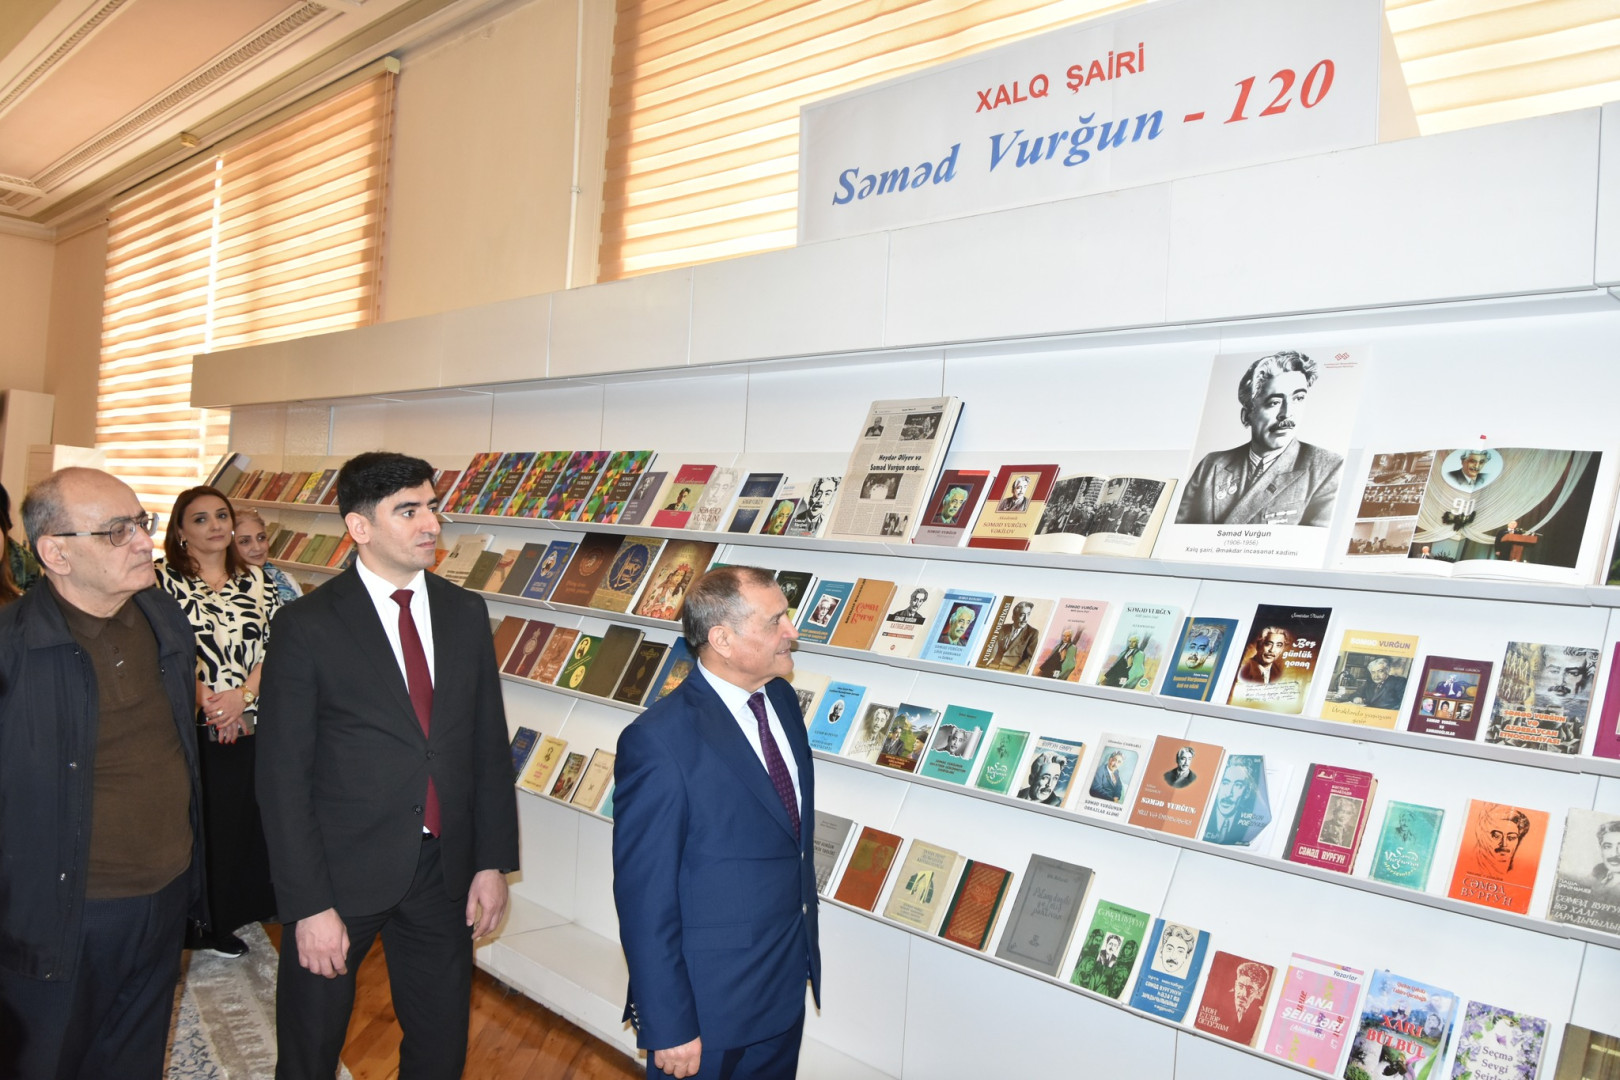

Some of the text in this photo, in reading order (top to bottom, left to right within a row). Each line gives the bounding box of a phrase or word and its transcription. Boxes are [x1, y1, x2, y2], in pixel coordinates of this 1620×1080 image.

[976, 42, 1145, 113] XALQ ŞAİRİ
[832, 143, 961, 205] Səməd
[988, 109, 1164, 172] Vurğun
[1224, 59, 1335, 124] 120
[879, 454, 896, 462] Heydər
[898, 454, 914, 462] Əliyev
[870, 463, 886, 471] Səməd
[887, 463, 905, 472] Vurğun
[1244, 530, 1272, 538] Vurğun
[1292, 638, 1316, 648] Beş
[1379, 641, 1410, 649] VURĞUN
[1282, 650, 1312, 659] günlük
[1285, 660, 1310, 669] qonaq
[1504, 710, 1532, 718] SƏMƏD
[1505, 725, 1558, 737] AZƏRBAYCAN
[1333, 970, 1358, 981] Yazarlar
[1304, 996, 1334, 1011] ANA
[1382, 1014, 1424, 1038] XARI
[1366, 1028, 1426, 1058] BÜLBÜL
[1482, 1046, 1513, 1062] Seçmə
[1482, 1059, 1509, 1075] Sevgi
